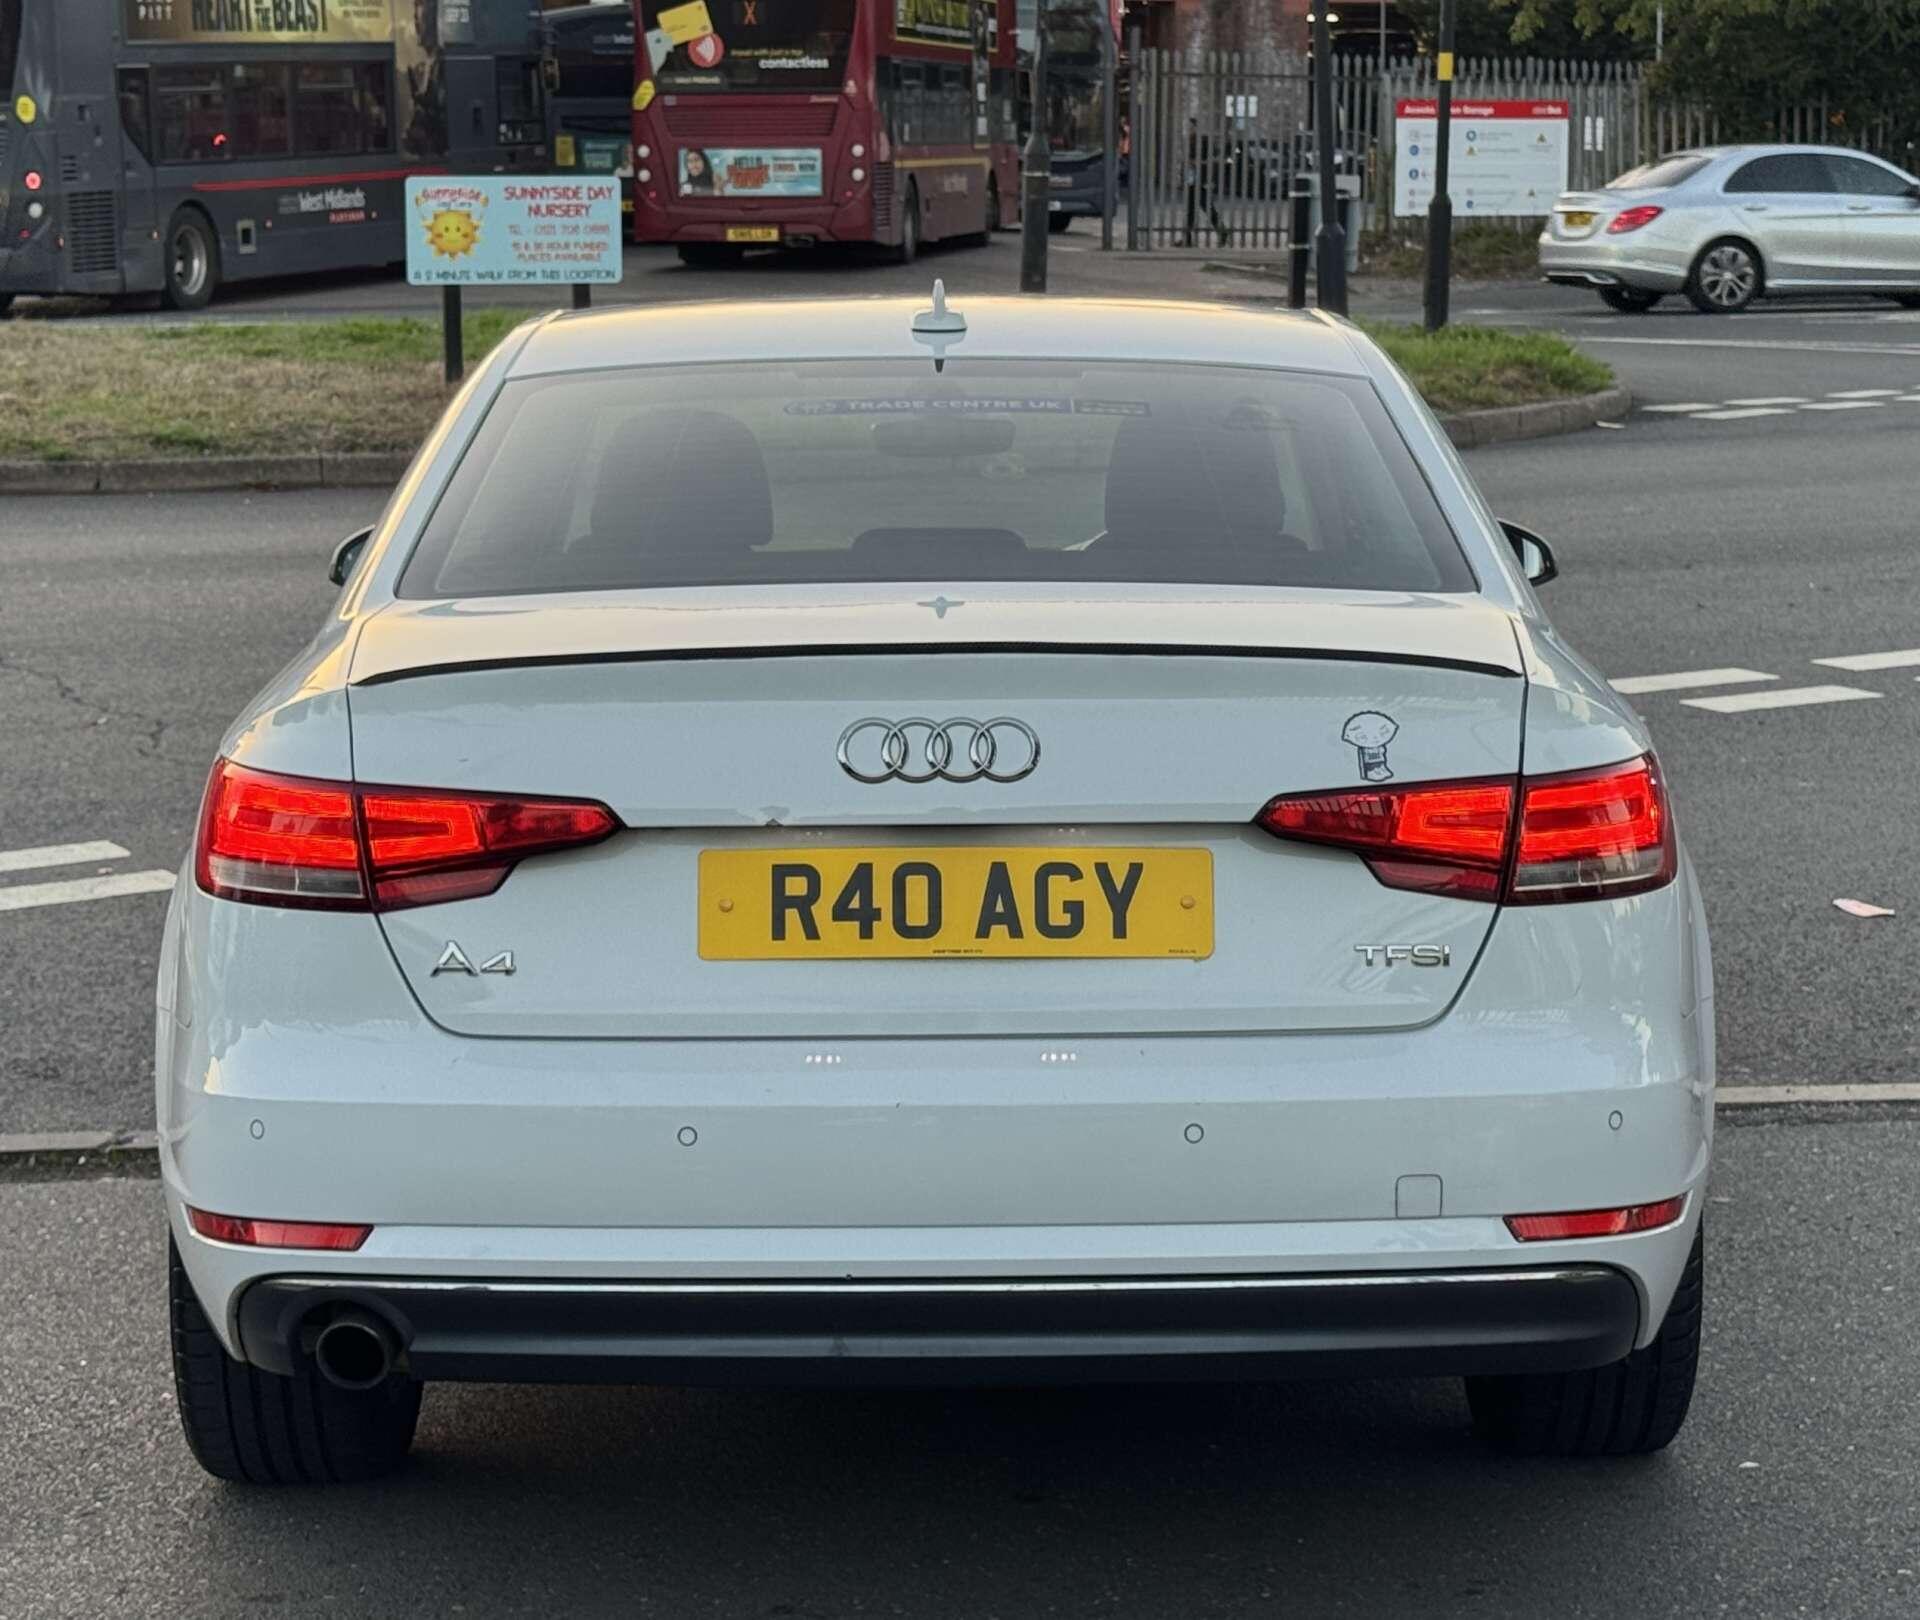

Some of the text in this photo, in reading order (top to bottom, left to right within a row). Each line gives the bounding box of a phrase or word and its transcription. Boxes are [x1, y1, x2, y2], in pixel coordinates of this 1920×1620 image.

[758, 56, 830, 69] contactless
[504, 186, 614, 200] SUNNYSIDE DAY
[528, 204, 592, 218] NURSERY
[507, 270, 537, 280] FROM
[564, 270, 616, 280] LOCATION
[848, 399, 926, 411] TRADE
[931, 399, 1023, 411] CENTRE
[771, 862, 1144, 941] R40 AGY
[430, 940, 517, 977] A4
[1354, 944, 1450, 967] TFSI
